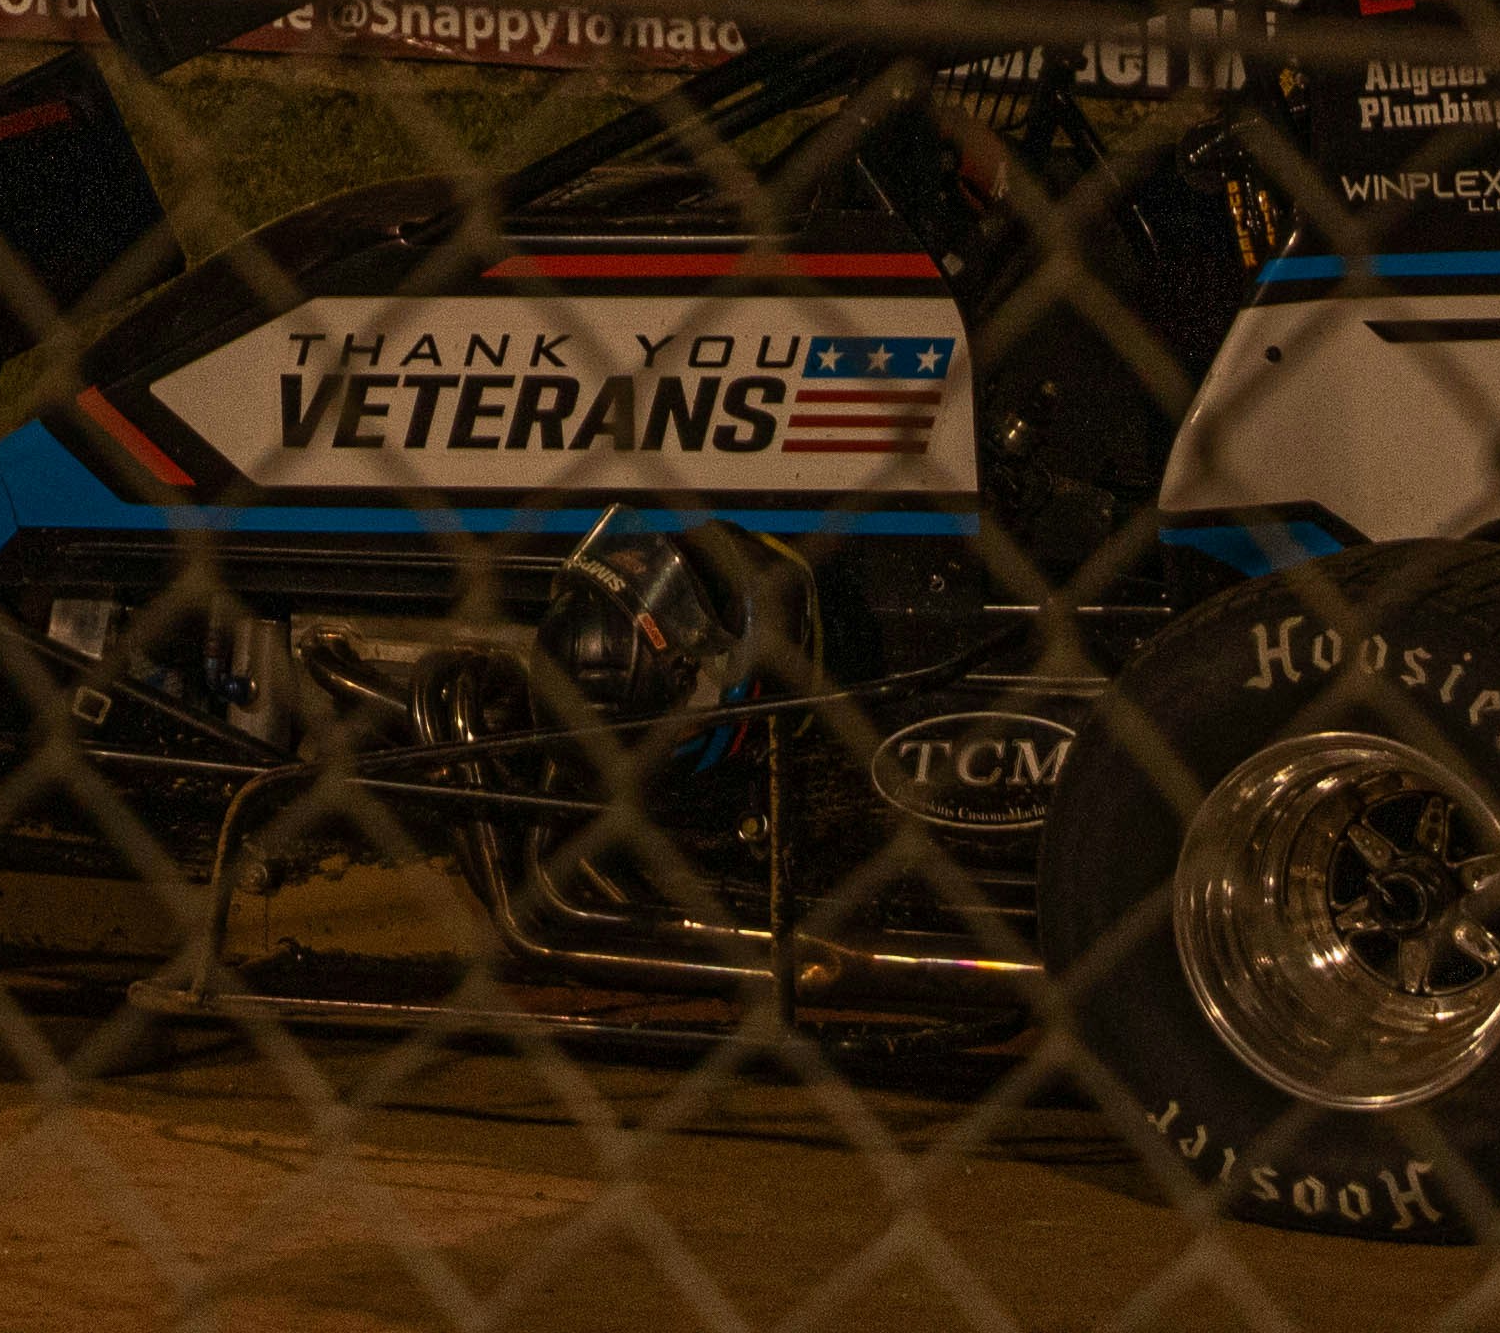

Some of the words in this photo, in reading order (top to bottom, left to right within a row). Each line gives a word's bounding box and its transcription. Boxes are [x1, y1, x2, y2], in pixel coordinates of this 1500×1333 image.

[288, 333, 570, 370] THANK
[640, 334, 801, 370] YOU
[280, 373, 788, 453] VETERANS
[899, 739, 1074, 787] TCM
[1145, 1099, 1445, 1231] Hoosier
